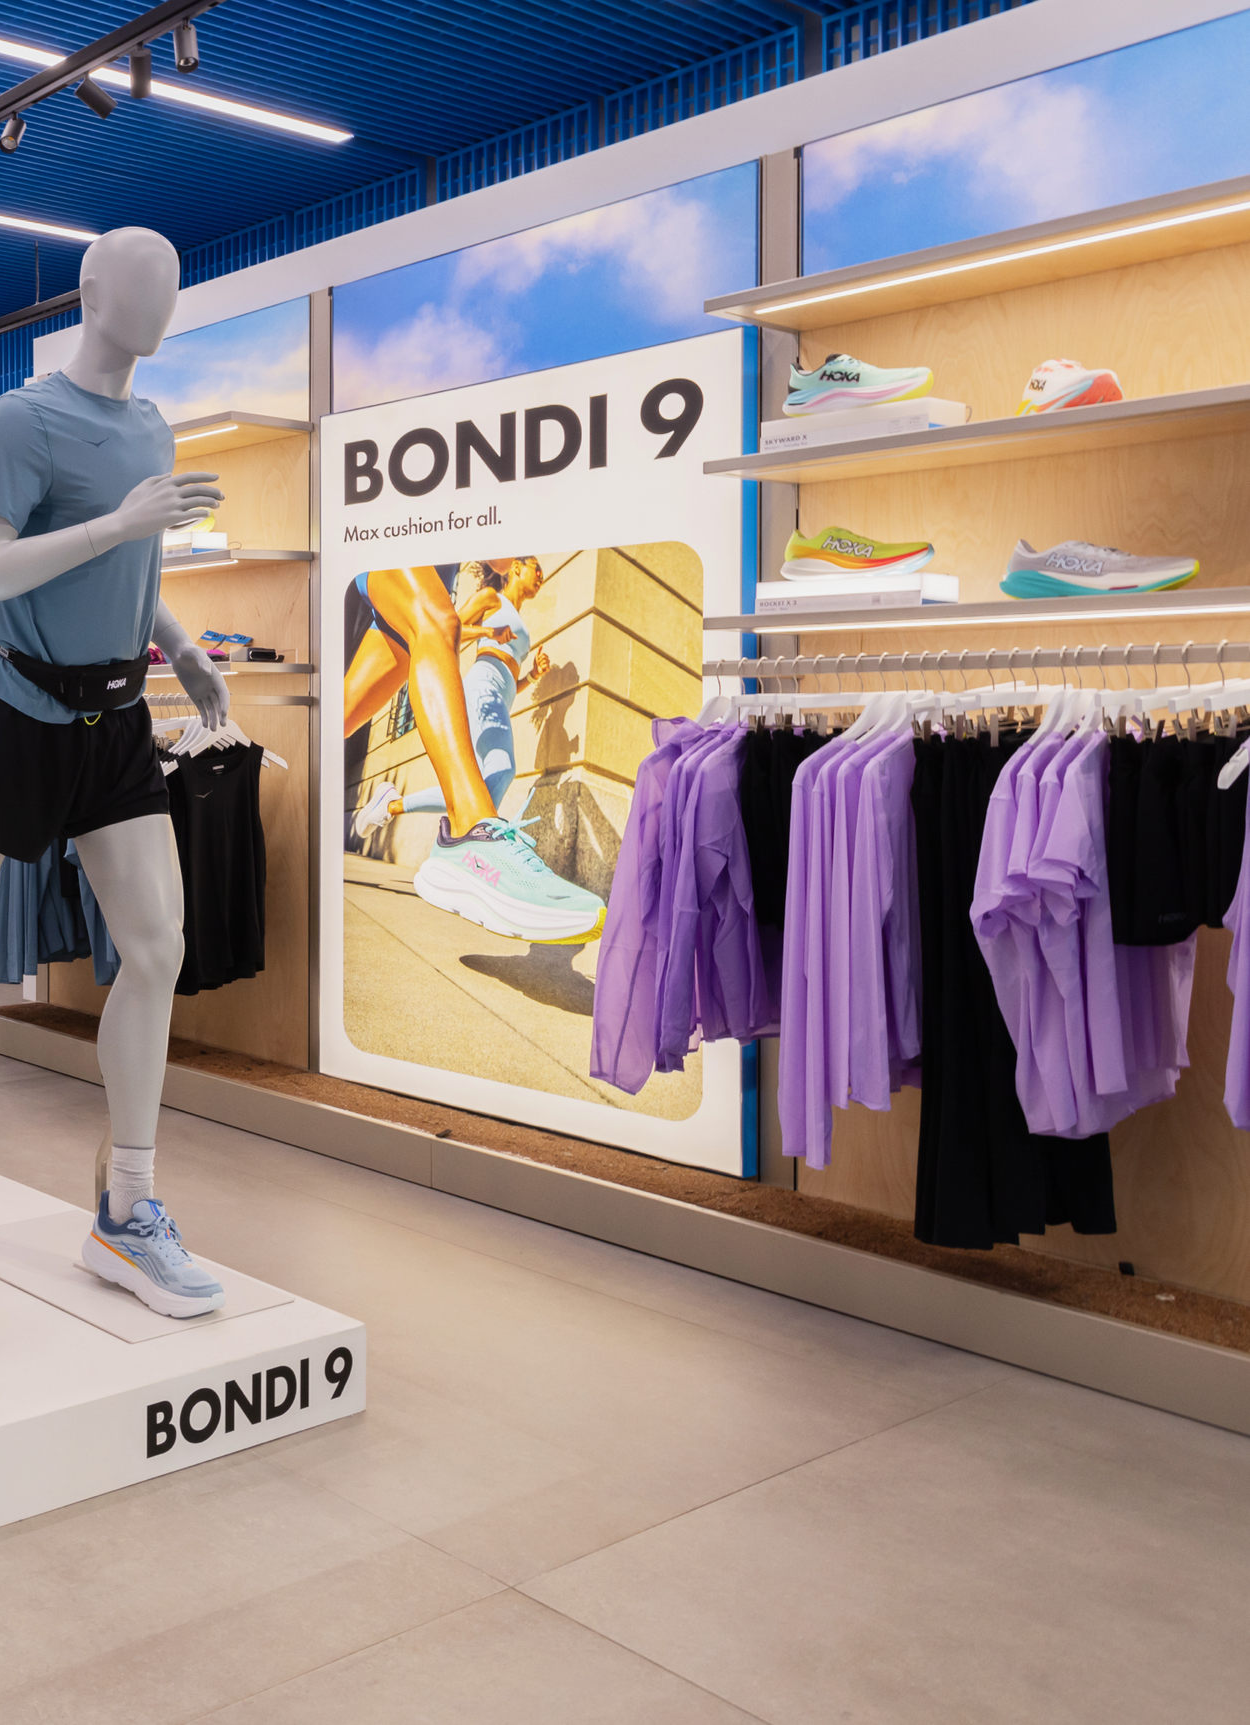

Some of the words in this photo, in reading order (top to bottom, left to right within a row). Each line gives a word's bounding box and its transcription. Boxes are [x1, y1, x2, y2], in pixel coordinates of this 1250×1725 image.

[819, 370, 861, 383] HOKA
[344, 393, 608, 506] BONDI
[640, 378, 705, 460] 9
[764, 435, 801, 446] SKYWARD
[802, 433, 808, 441] X
[344, 525, 380, 543] Max
[383, 516, 444, 538] cushion
[448, 511, 473, 530] for
[476, 505, 502, 526] all.
[821, 535, 875, 559] HOKA
[1044, 552, 1105, 574] HOKA
[106, 677, 127, 690] HOKA
[461, 850, 502, 888] HOKA
[146, 1357, 310, 1459] BONDI
[324, 1346, 353, 1400] 9
